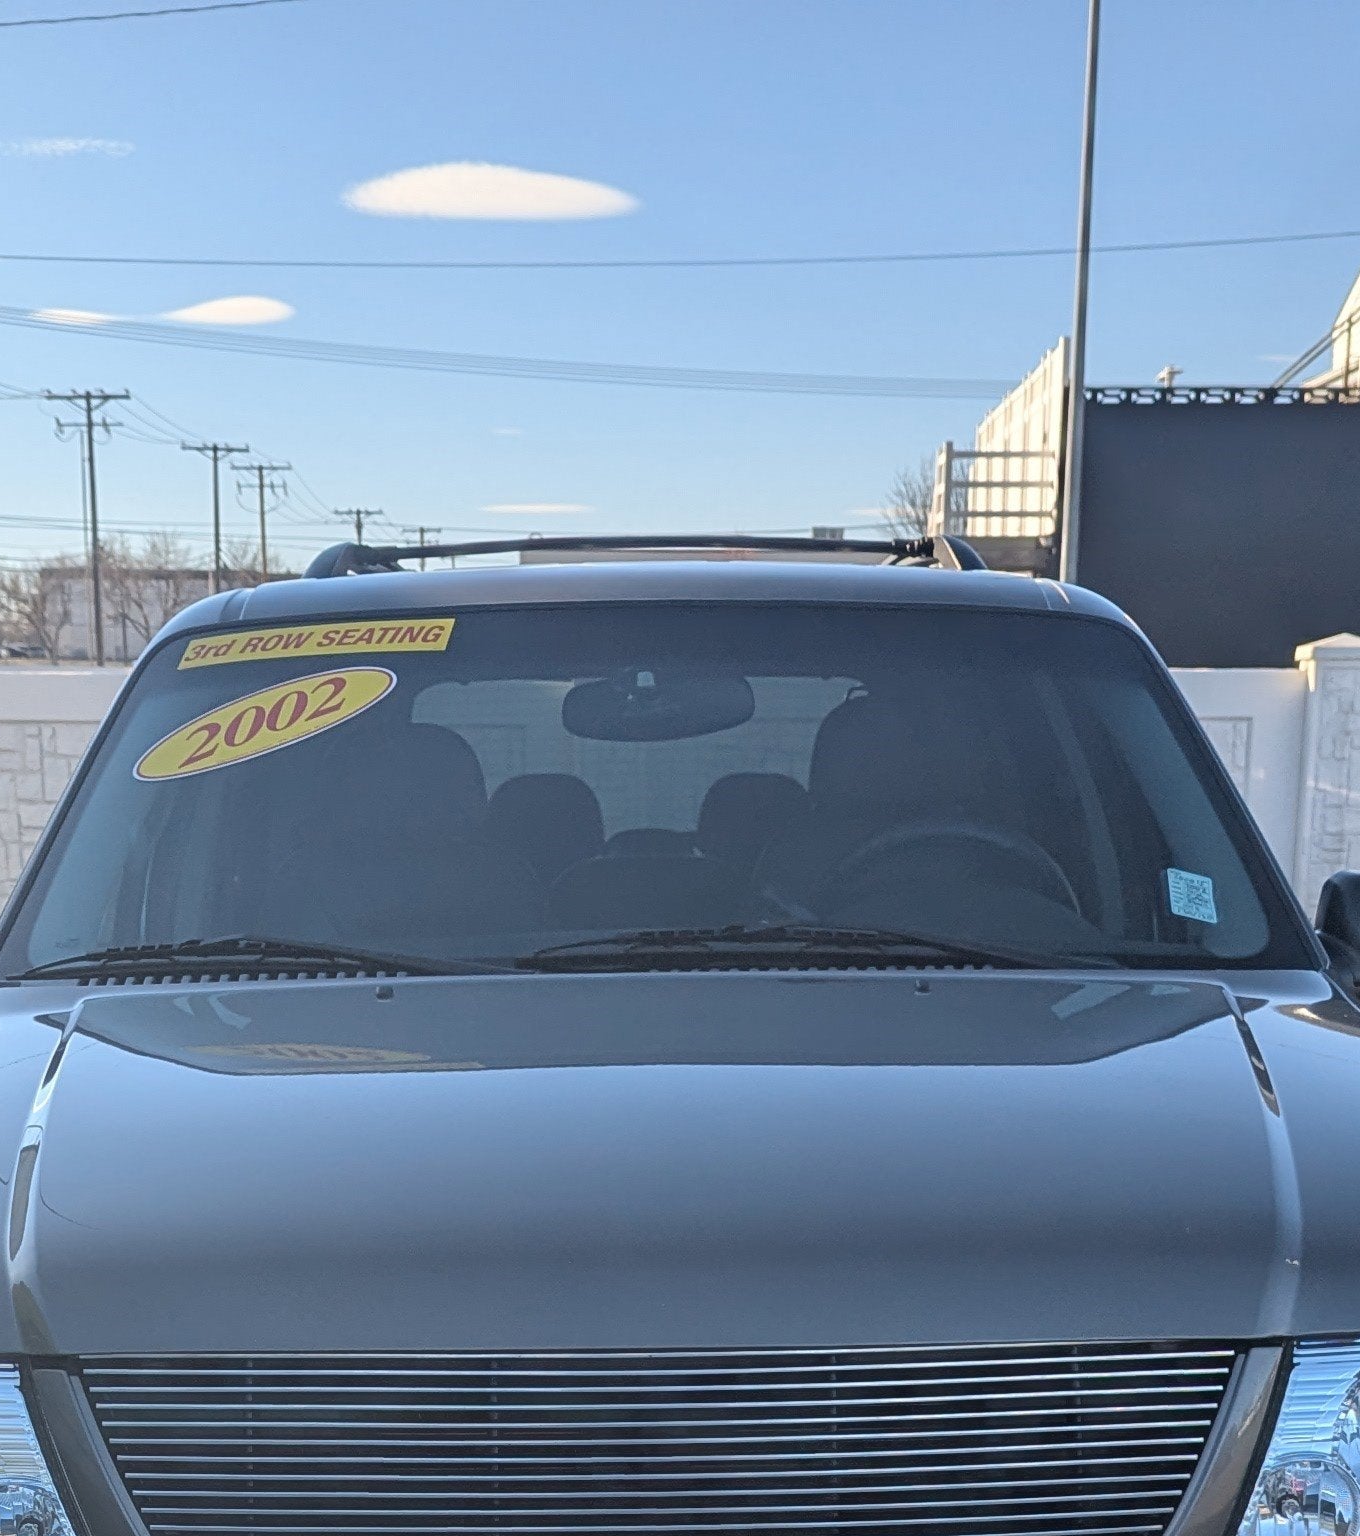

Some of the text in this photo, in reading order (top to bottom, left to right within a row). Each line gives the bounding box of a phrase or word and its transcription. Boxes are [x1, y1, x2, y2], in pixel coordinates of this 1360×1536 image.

[184, 625, 445, 662] 3rd ROW SEATING
[178, 676, 348, 770] 2002
